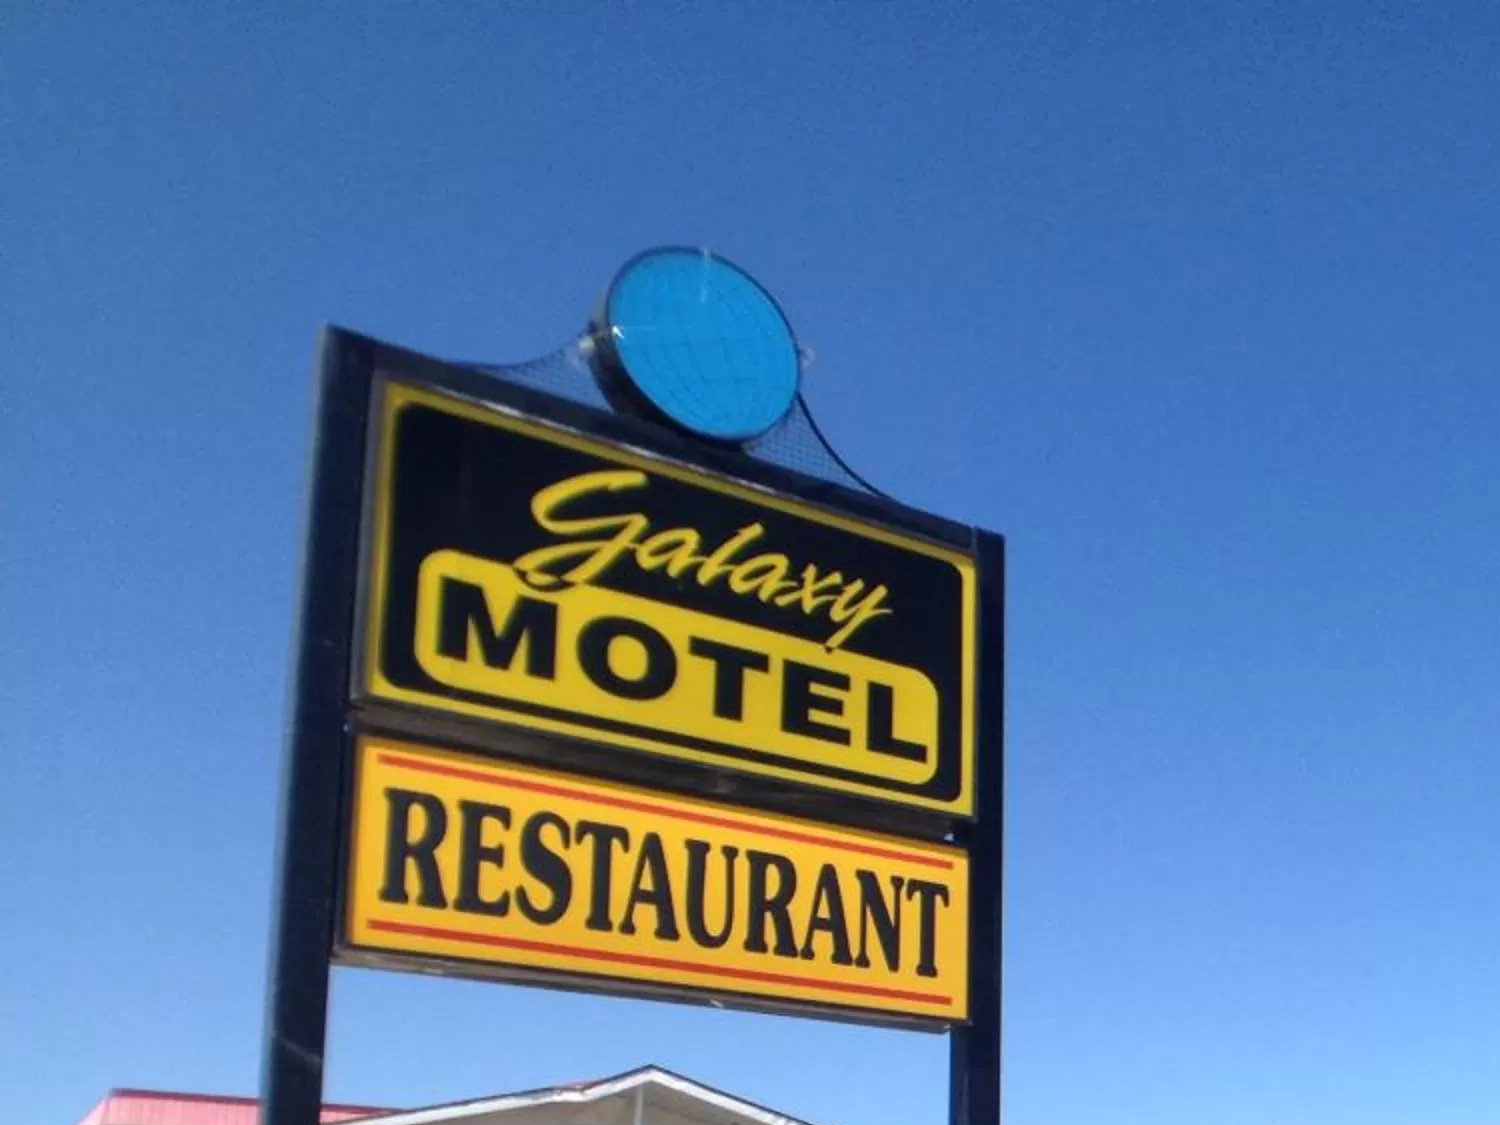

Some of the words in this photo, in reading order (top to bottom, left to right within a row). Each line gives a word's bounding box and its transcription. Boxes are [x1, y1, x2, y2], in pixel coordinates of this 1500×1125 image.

[514, 469, 892, 653] Galaxy
[435, 574, 928, 764] MOTEL
[377, 786, 950, 977] RESTAURANT
